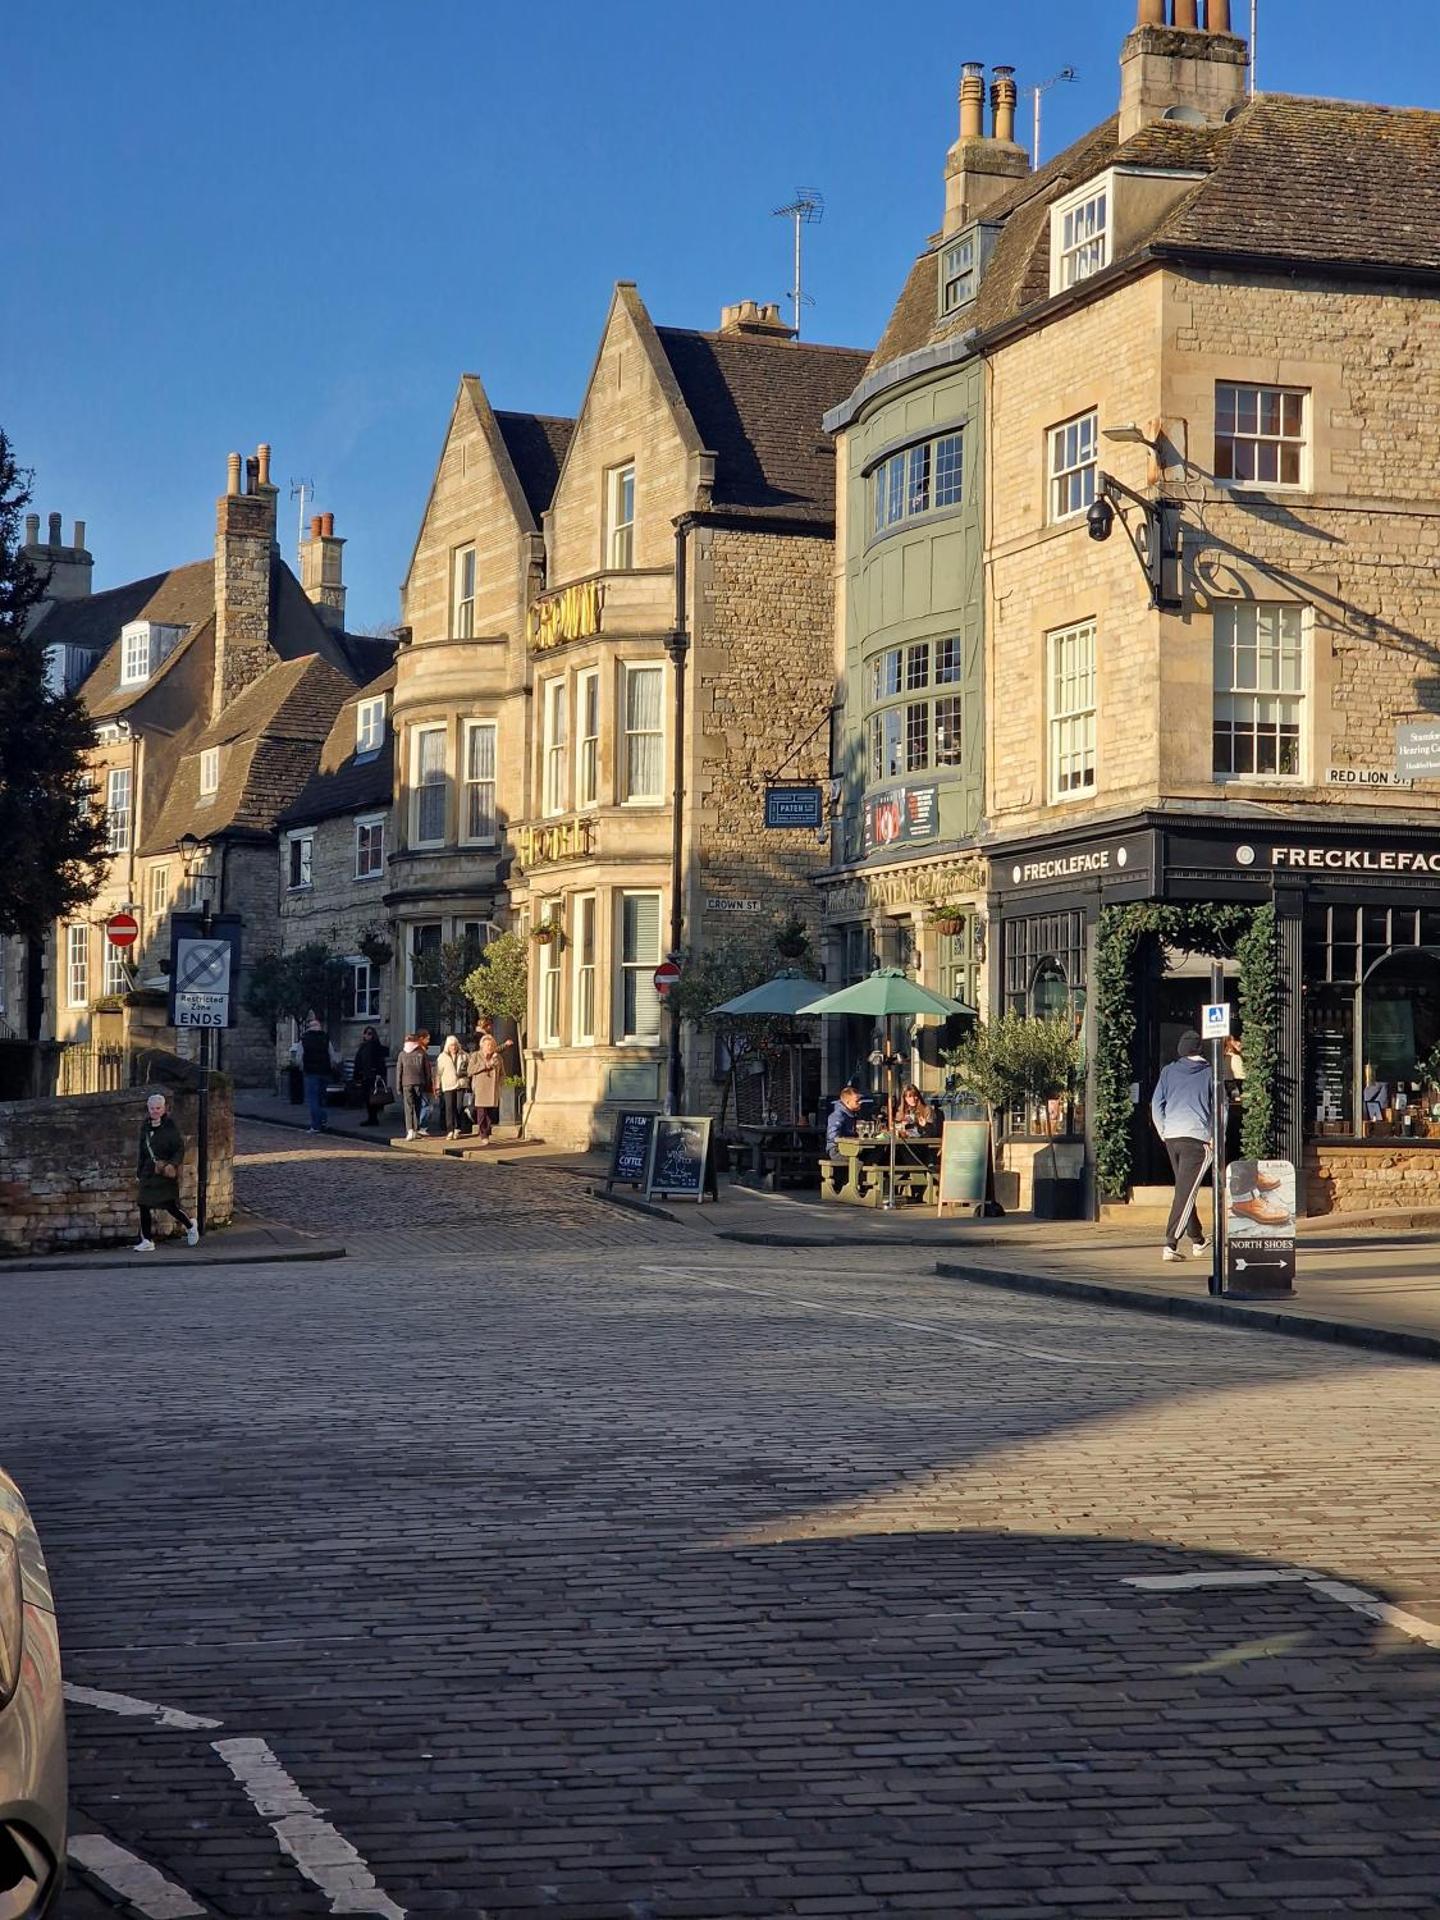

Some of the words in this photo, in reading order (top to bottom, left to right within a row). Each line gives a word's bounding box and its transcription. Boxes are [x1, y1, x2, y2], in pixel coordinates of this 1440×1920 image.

[1330, 770, 1356, 782] RED
[1359, 771, 1388, 784] LION
[520, 817, 585, 867] HOTEL
[1023, 850, 1109, 881] FRECKLEFACE
[1271, 848, 1440, 871] FRECKLEFAC
[708, 900, 743, 910] CROWN
[747, 900, 757, 910] ST
[181, 995, 224, 1004] Restricted
[191, 1003, 211, 1011] Zone
[180, 1013, 222, 1025] ENDS
[1231, 1240, 1262, 1249] NORTH
[1264, 1240, 1294, 1249] SHOES
